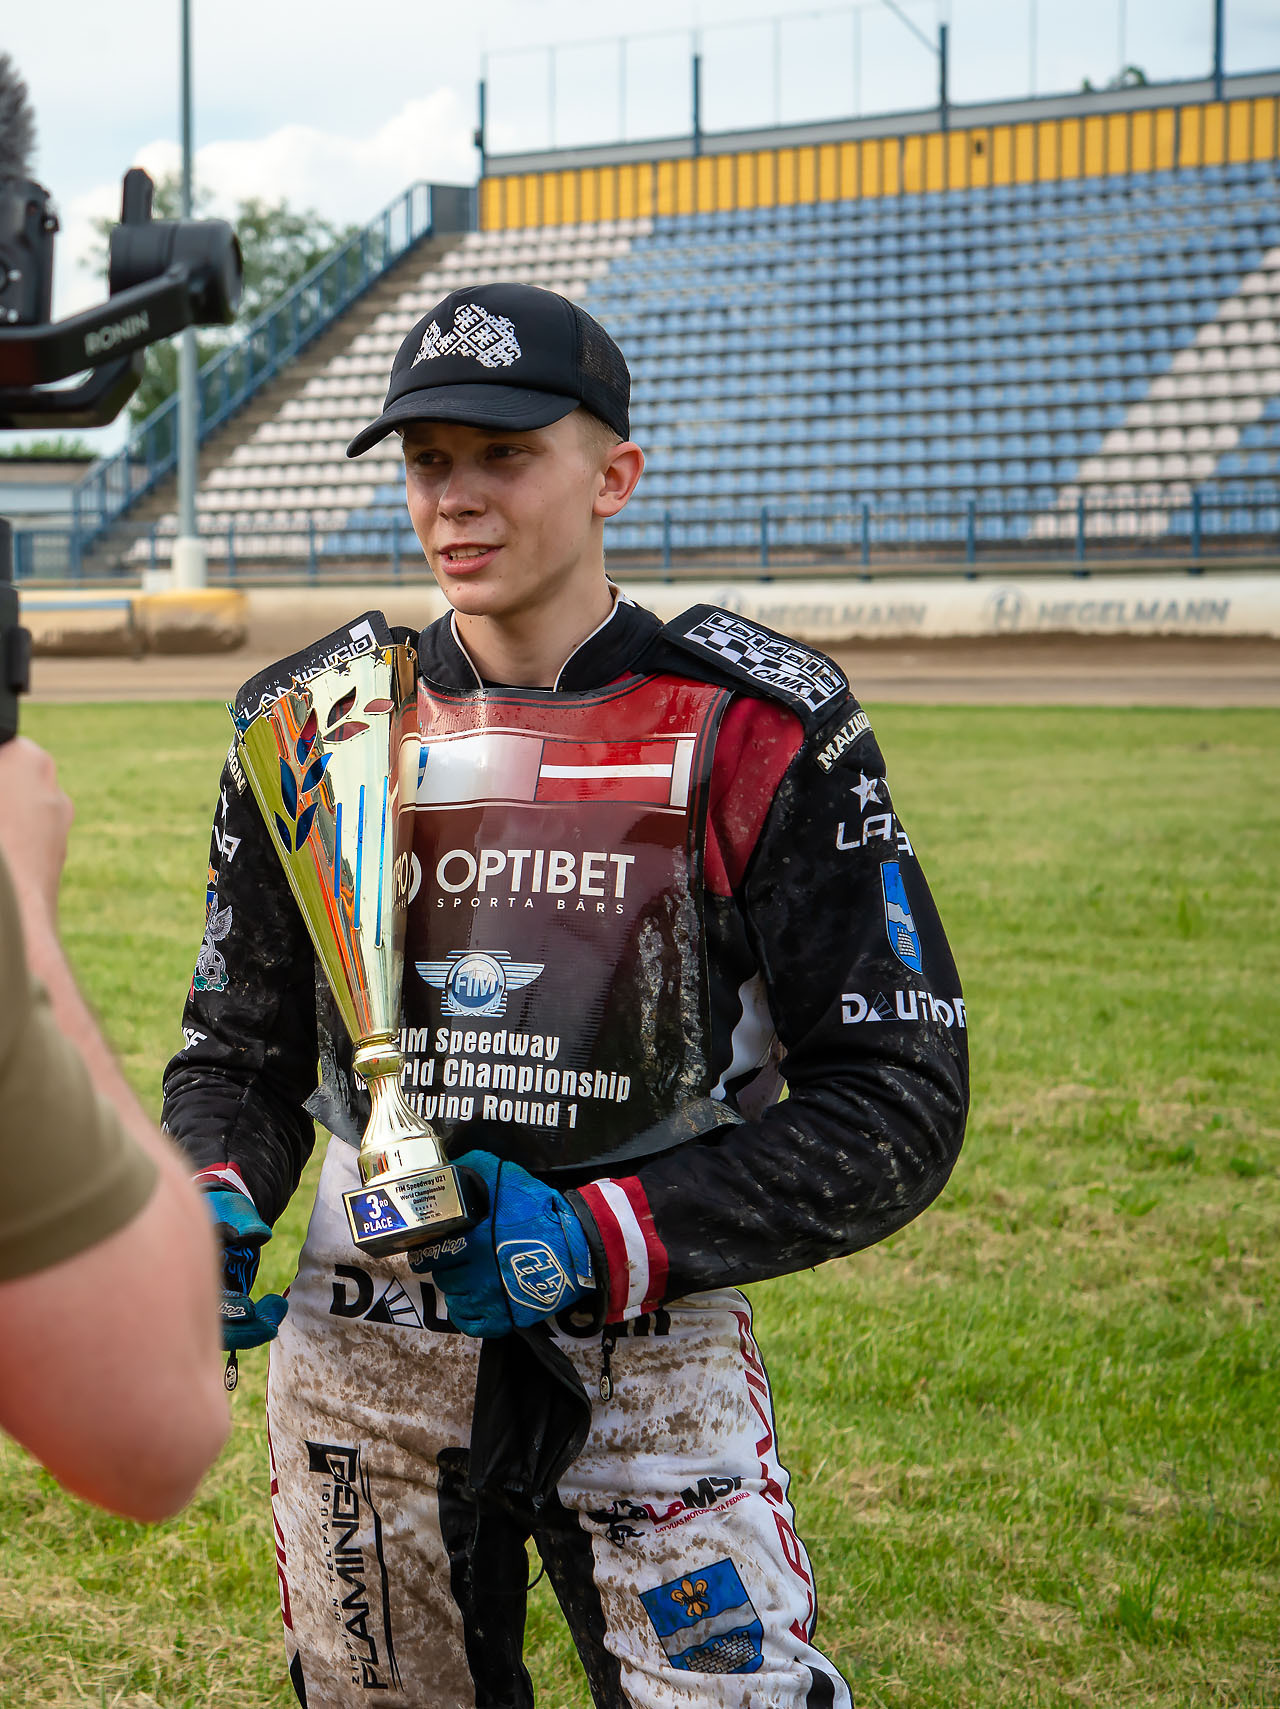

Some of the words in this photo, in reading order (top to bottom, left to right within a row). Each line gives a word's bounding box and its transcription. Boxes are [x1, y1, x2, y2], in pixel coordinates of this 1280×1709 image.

[84, 309, 150, 357] RONIN
[1037, 599, 1232, 625] HEGELMANN
[436, 849, 636, 899] OPTIBET
[437, 897, 534, 909] SPORTA
[556, 898, 625, 915] BĀRS
[454, 969, 497, 999] FIM
[397, 1027, 429, 1053] IM
[435, 1028, 560, 1061] Speedway
[401, 1058, 435, 1087] rld
[443, 1059, 631, 1102] Championship
[482, 1095, 560, 1128] Round
[567, 1103, 578, 1129] 1
[406, 1178, 434, 1191] Speedway
[363, 1217, 393, 1233] PLACE
[320, 1483, 336, 1584] TELPAUGI
[308, 1441, 388, 1690] FLAMINGO
[332, 1598, 342, 1621] UN
